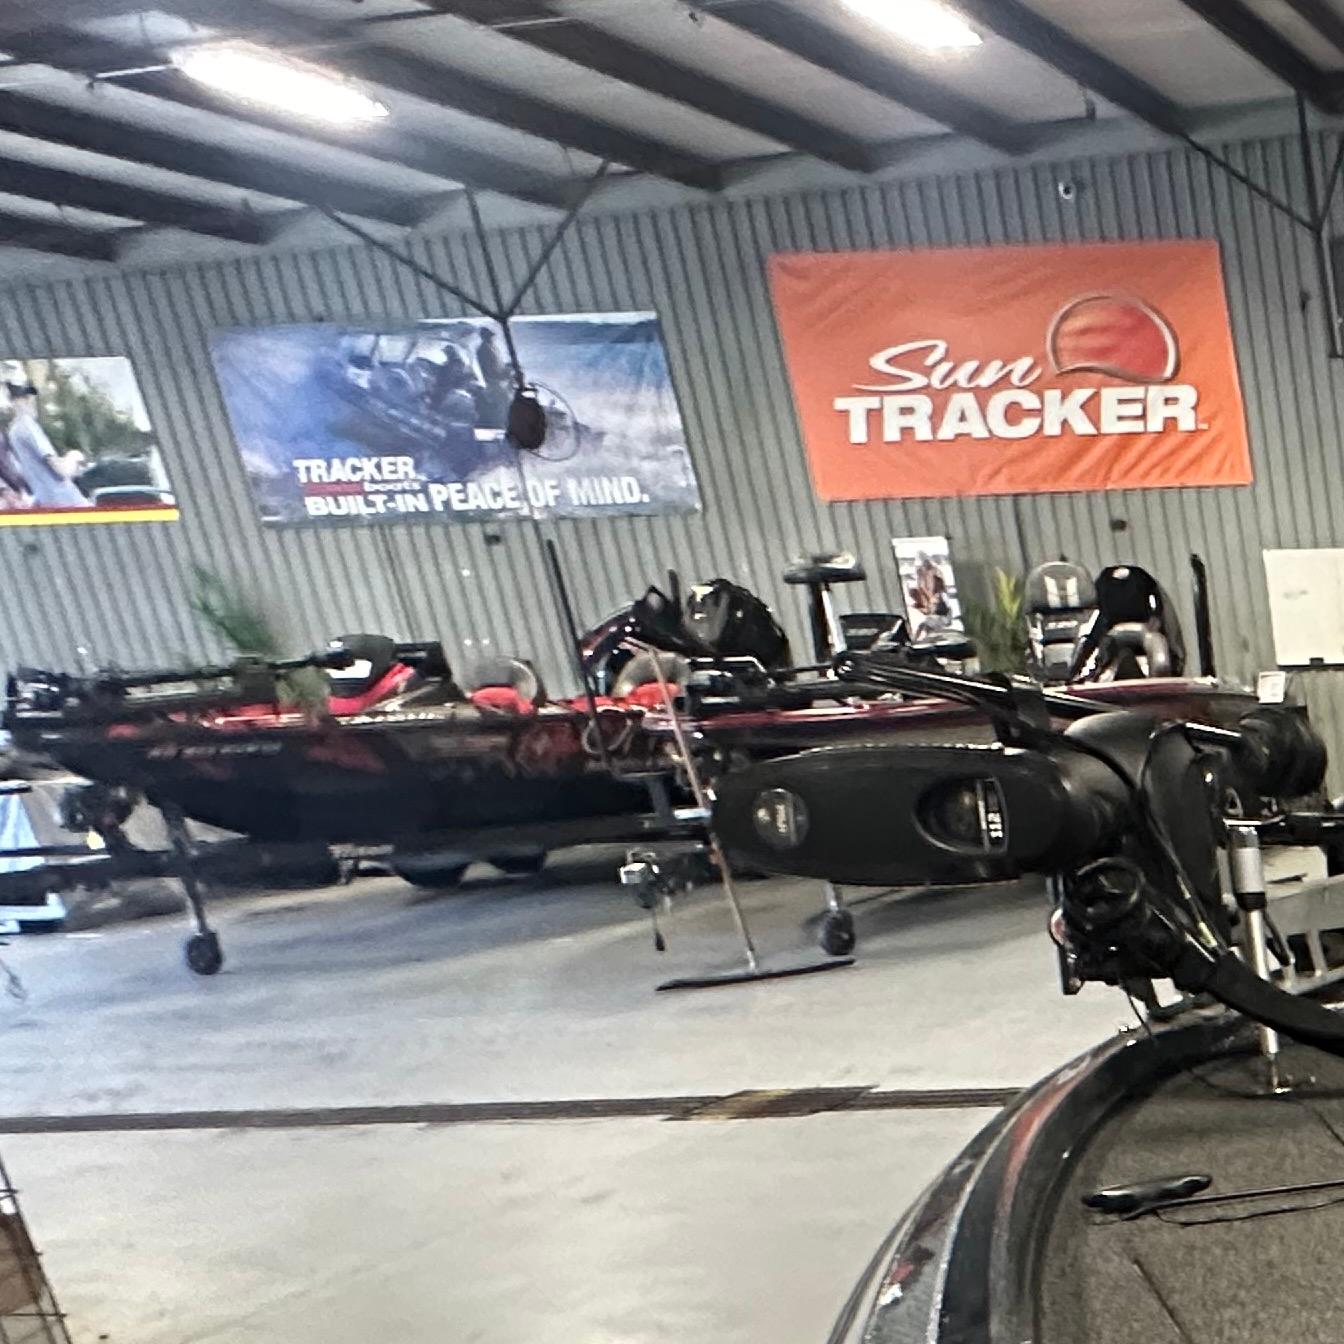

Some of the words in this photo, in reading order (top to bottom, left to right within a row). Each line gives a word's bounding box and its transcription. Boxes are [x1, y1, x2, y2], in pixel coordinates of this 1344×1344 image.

[852, 338, 1043, 392] Sun
[833, 384, 1198, 444] TRACKER
[293, 455, 416, 484] TRACKER
[304, 492, 429, 516] BUILT-IN
[427, 481, 520, 512] PEACE
[526, 480, 560, 508] OF
